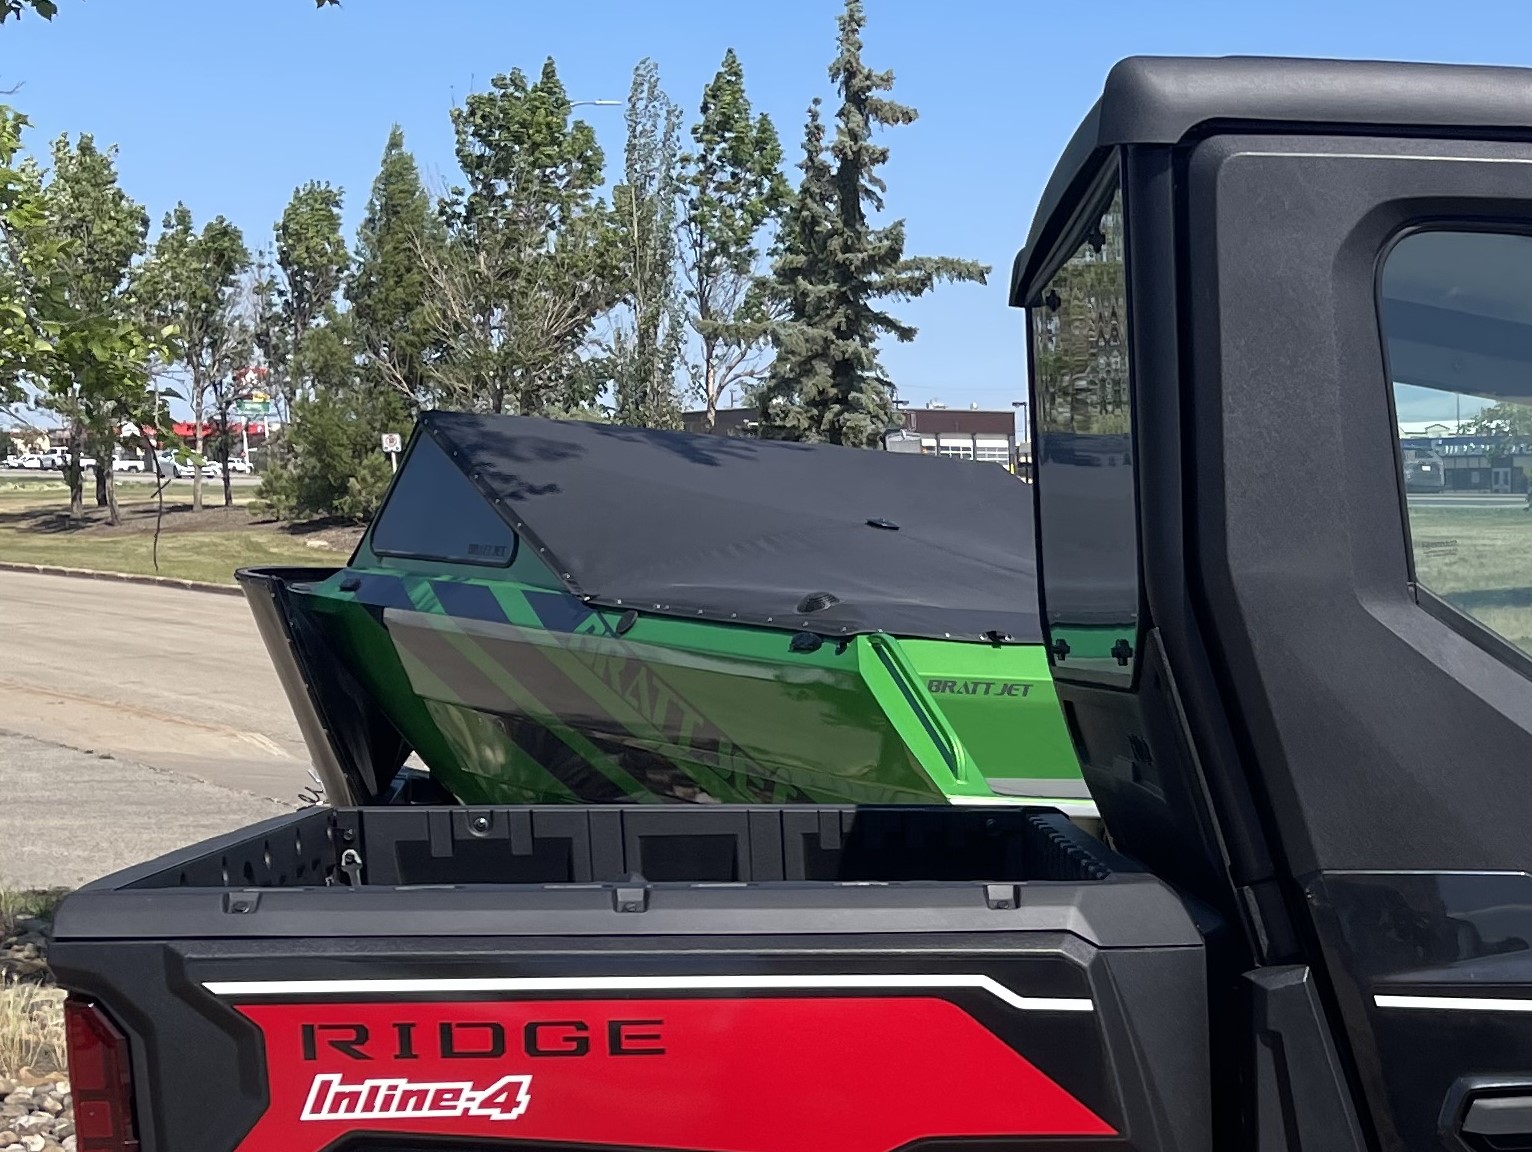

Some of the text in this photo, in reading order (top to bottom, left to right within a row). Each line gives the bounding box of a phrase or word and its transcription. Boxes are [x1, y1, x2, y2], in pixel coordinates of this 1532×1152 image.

[927, 679, 1034, 697] BRATT JET
[301, 1019, 666, 1061] RIDGE
[301, 1073, 533, 1121] Inline-4
